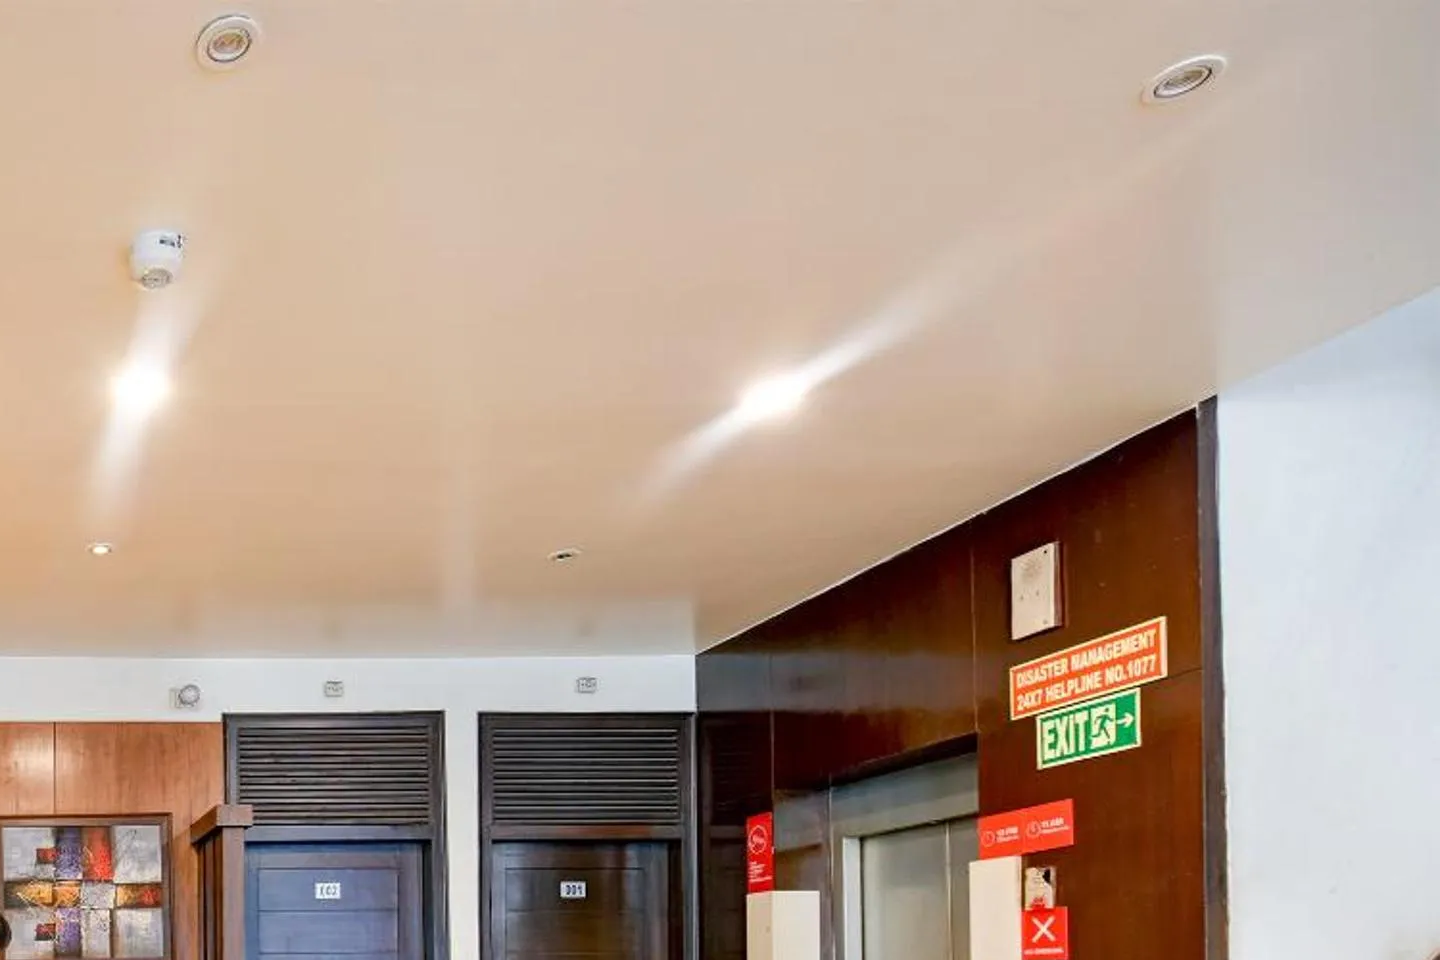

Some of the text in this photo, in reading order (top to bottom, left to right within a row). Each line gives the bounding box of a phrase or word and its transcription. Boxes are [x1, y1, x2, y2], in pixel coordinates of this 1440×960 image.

[1016, 629, 1157, 689] DISASTER MANAGEMENT
[1017, 688, 1043, 711] 24X7
[1045, 671, 1103, 703] HELPLINE
[1042, 712, 1089, 760] EXIT
